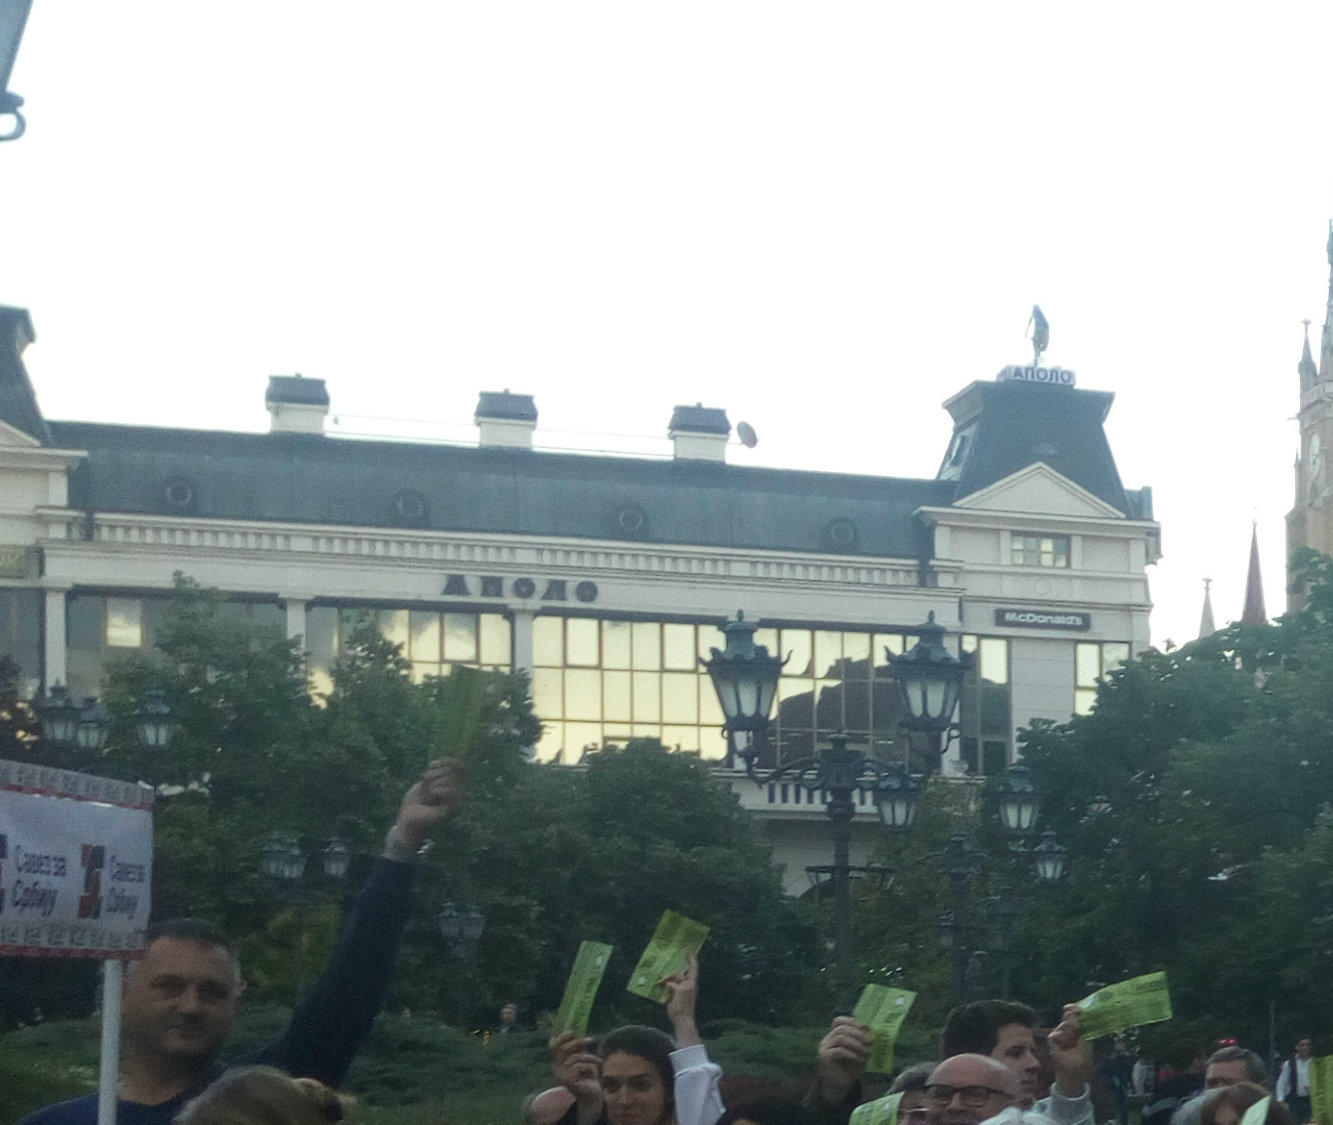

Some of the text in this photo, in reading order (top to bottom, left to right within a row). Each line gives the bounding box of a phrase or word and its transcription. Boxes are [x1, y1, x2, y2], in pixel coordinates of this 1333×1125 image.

[1013, 366, 1072, 383] АПОЛО
[441, 574, 599, 603] АПОЛО
[1004, 610, 1083, 627] McDonald's
